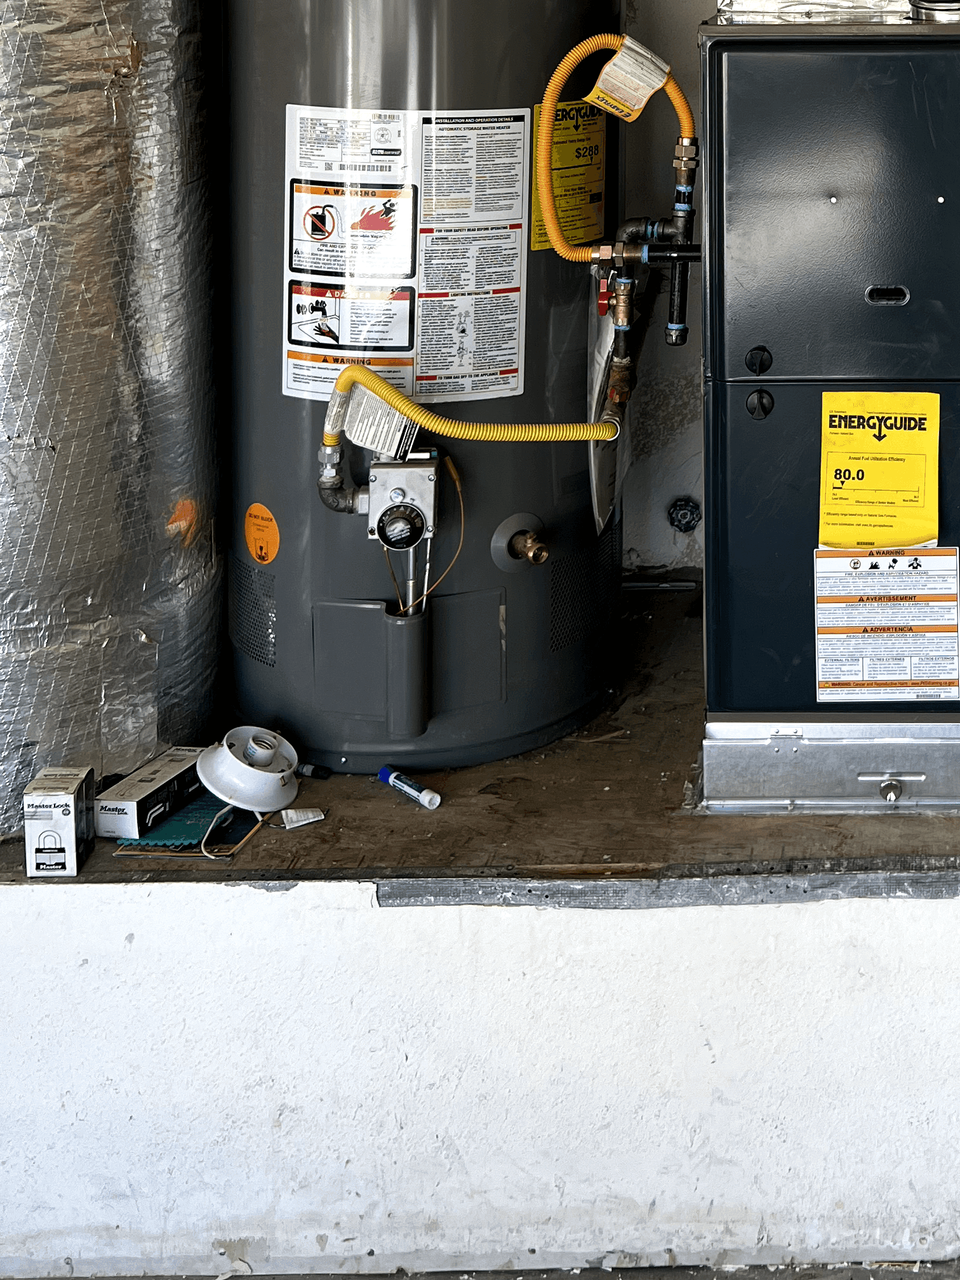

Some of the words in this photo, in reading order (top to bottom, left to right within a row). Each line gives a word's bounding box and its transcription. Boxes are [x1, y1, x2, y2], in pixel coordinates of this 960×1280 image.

[575, 144, 599, 159] $288
[334, 189, 377, 197] WANING
[333, 357, 372, 365] WARNING
[829, 414, 927, 438] ENERGYGUIDE
[834, 468, 865, 481] 80.0
[99, 805, 126, 813] Master
